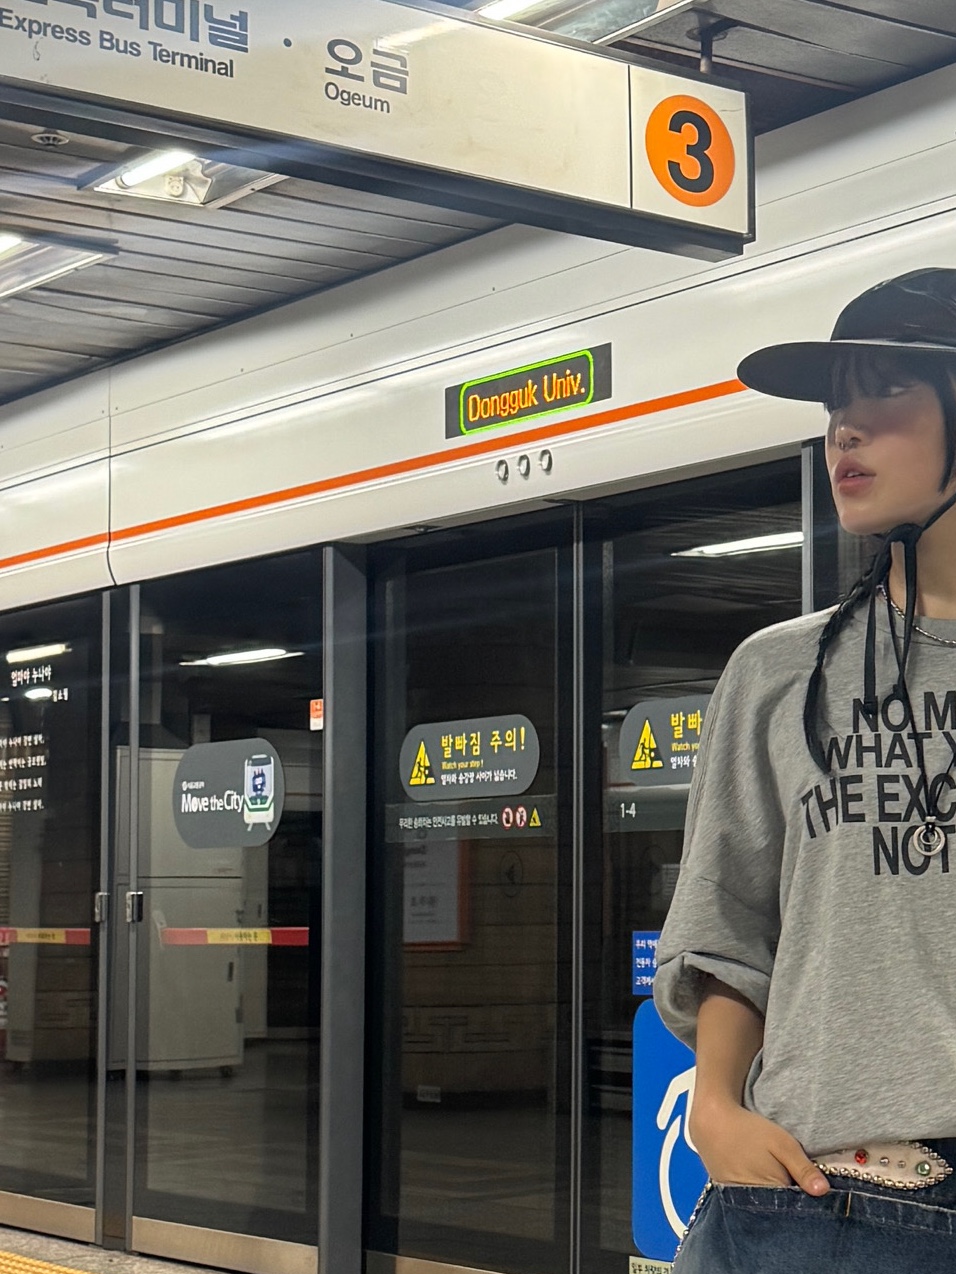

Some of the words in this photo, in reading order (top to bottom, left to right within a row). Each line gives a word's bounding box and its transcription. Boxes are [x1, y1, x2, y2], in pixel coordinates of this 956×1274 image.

[0, 8, 91, 46] Express
[99, 30, 141, 57] Bus
[148, 41, 234, 78] Terminal
[24, 0, 249, 53] 터미널
[325, 39, 409, 95] 오금
[324, 82, 390, 113] Ogeum
[667, 110, 713, 193] 3
[468, 380, 538, 422] Dongguk
[543, 369, 585, 402] Univ.
[671, 710, 703, 738] 발빠
[852, 693, 911, 733] NO
[441, 731, 480, 758] 발빠짐
[490, 726, 525, 753] 주의!
[825, 732, 932, 772] WHAT
[181, 793, 209, 813] Move
[210, 795, 223, 811] the
[224, 790, 244, 813] City
[620, 802, 636, 818] 1-4
[801, 774, 866, 838] THE
[873, 825, 956, 876] NOT
